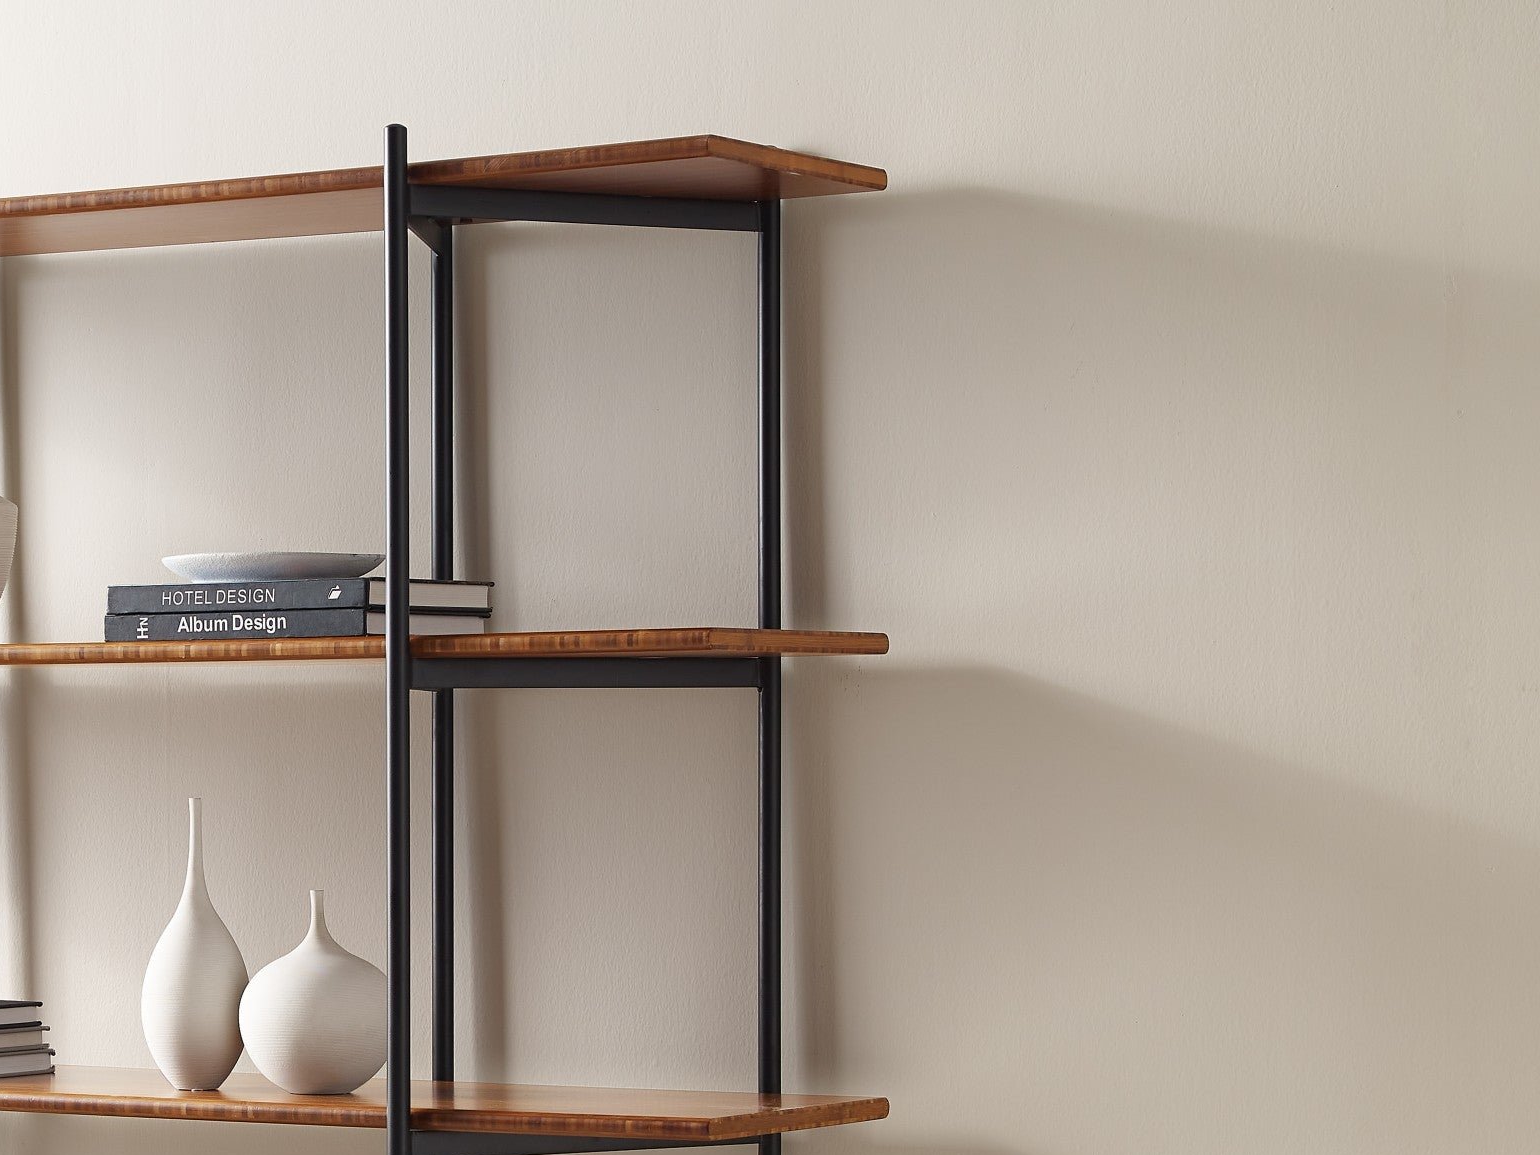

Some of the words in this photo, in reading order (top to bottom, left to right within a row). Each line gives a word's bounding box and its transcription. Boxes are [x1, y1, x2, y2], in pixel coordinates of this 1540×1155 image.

[162, 590, 212, 606] HOTEL
[216, 588, 275, 604] DESIGN
[177, 616, 228, 633] Album
[232, 613, 287, 634] Design
